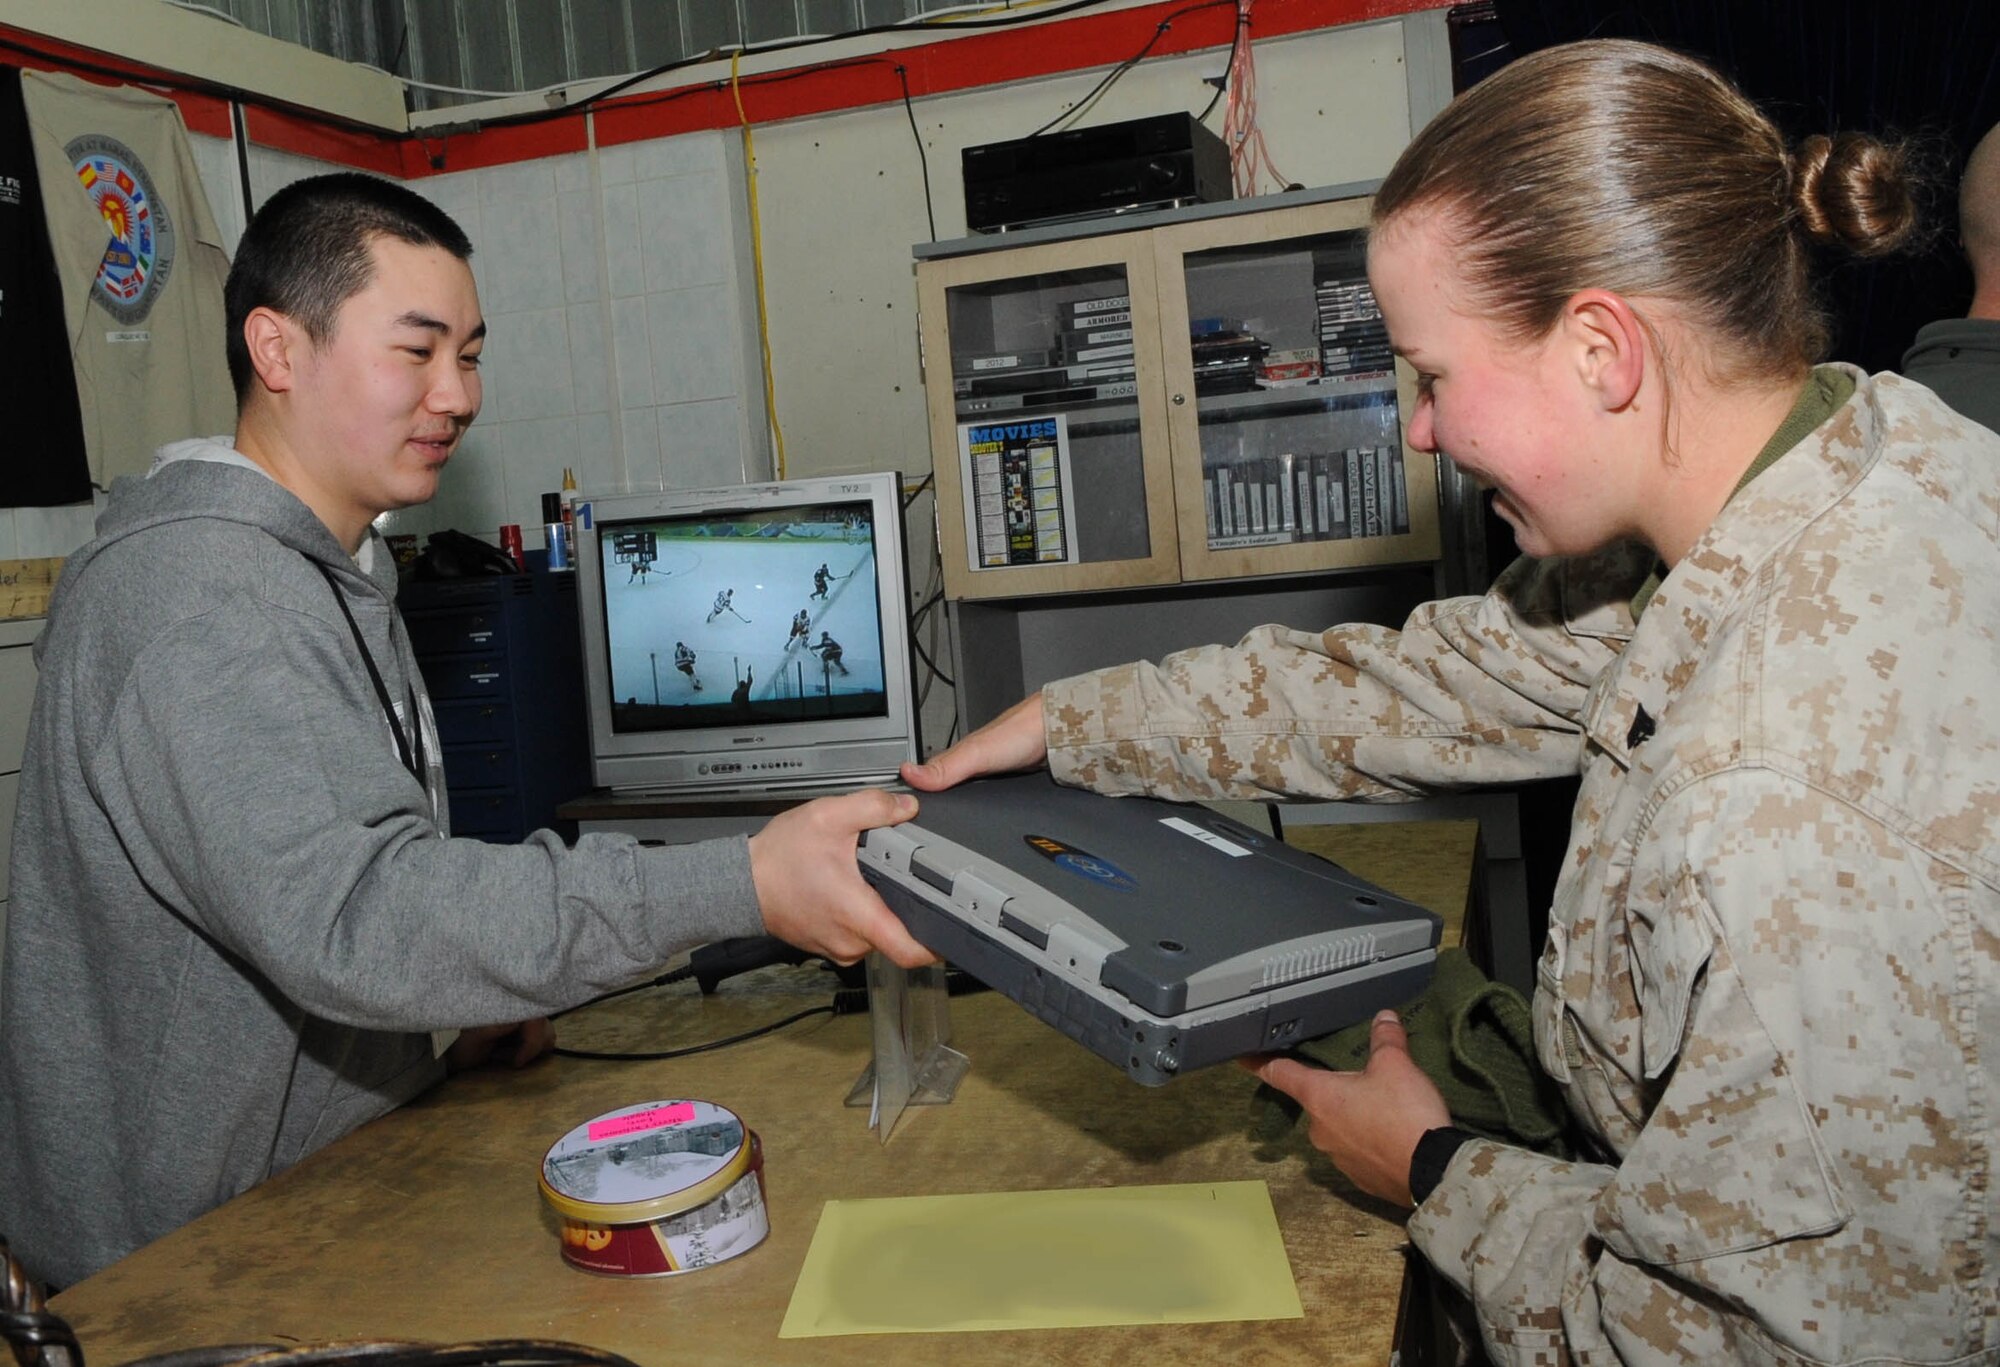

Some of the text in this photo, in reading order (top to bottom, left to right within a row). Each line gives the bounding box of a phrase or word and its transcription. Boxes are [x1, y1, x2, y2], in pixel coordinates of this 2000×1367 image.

[1087, 314, 1128, 326] ARMORED
[985, 358, 1005, 368] 2012
[969, 421, 1057, 443] MOVIES
[841, 484, 859, 493] TV 2
[576, 503, 593, 530] 1
